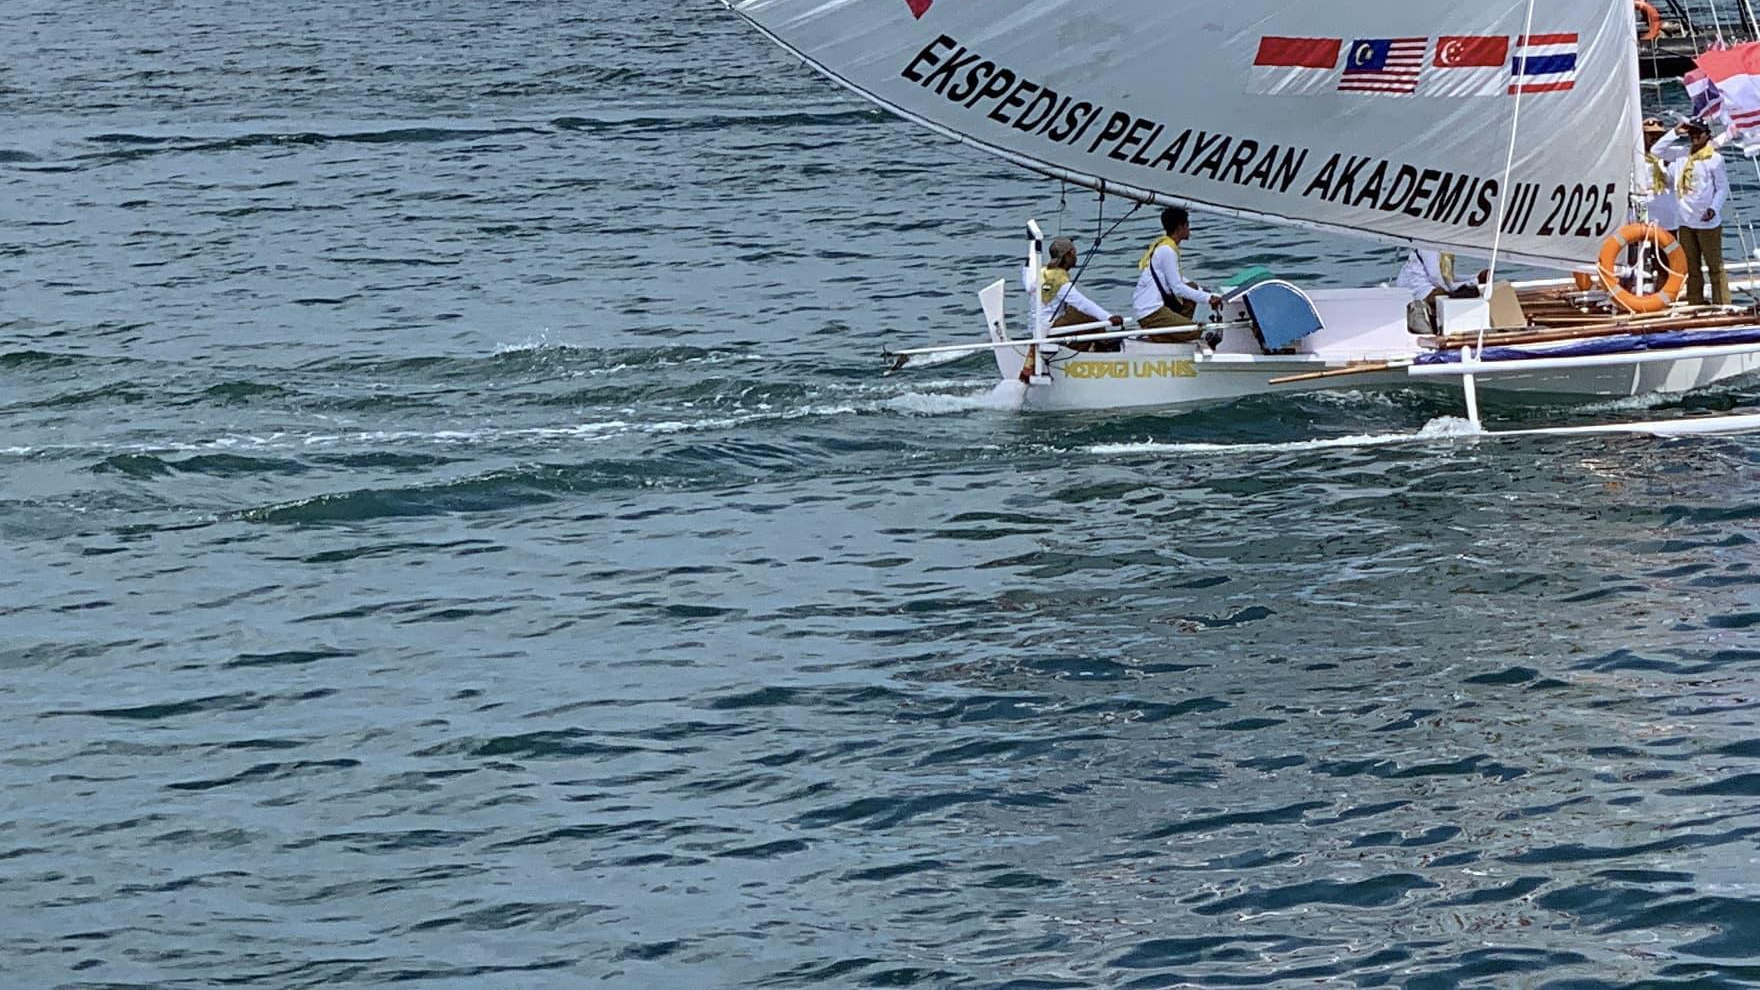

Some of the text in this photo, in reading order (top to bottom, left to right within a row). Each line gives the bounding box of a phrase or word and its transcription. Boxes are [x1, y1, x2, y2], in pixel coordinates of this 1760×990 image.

[900, 33, 1616, 238] EKSPEDISI PELAYARAN AKADEMIS III 2025
